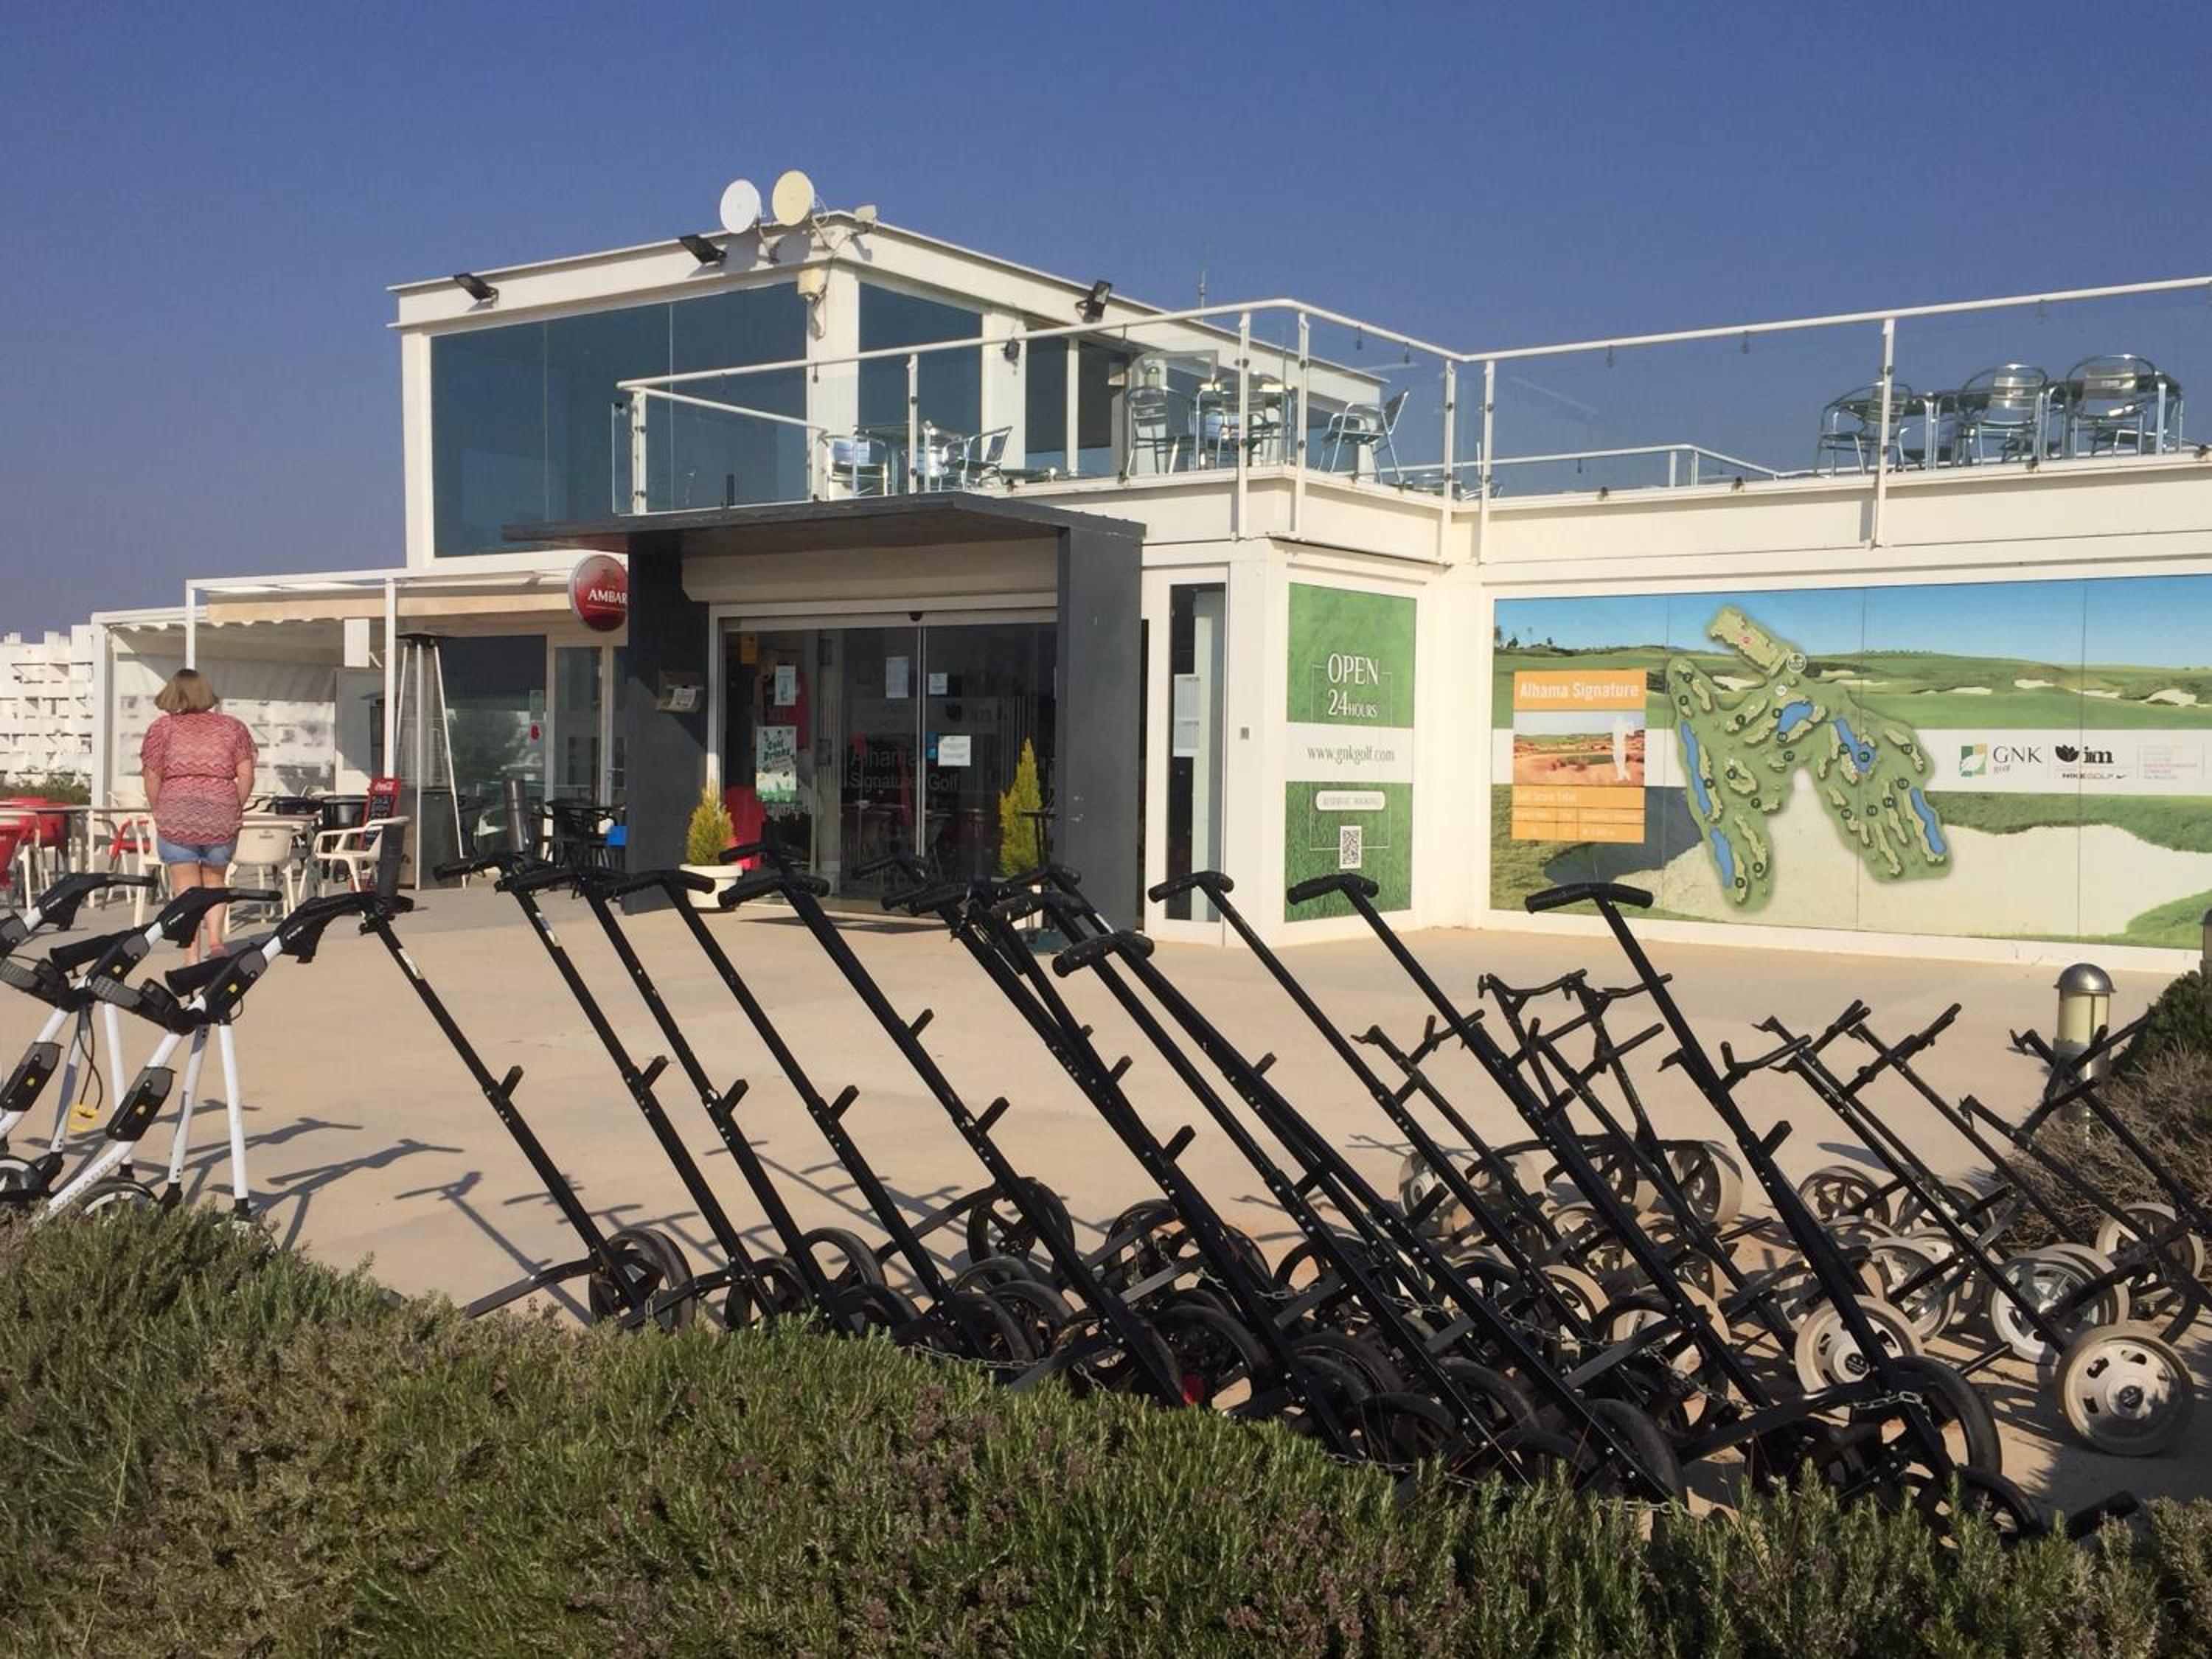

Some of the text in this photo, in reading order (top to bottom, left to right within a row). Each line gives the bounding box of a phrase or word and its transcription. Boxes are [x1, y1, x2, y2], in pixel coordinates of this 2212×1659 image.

[1327, 653, 1379, 685] OPEN
[1520, 681, 1639, 700] Alhama Signature
[1328, 689, 1347, 715] 24
[1307, 745, 1395, 765] www.gnkgolf.com
[1993, 745, 2042, 763] GNK
